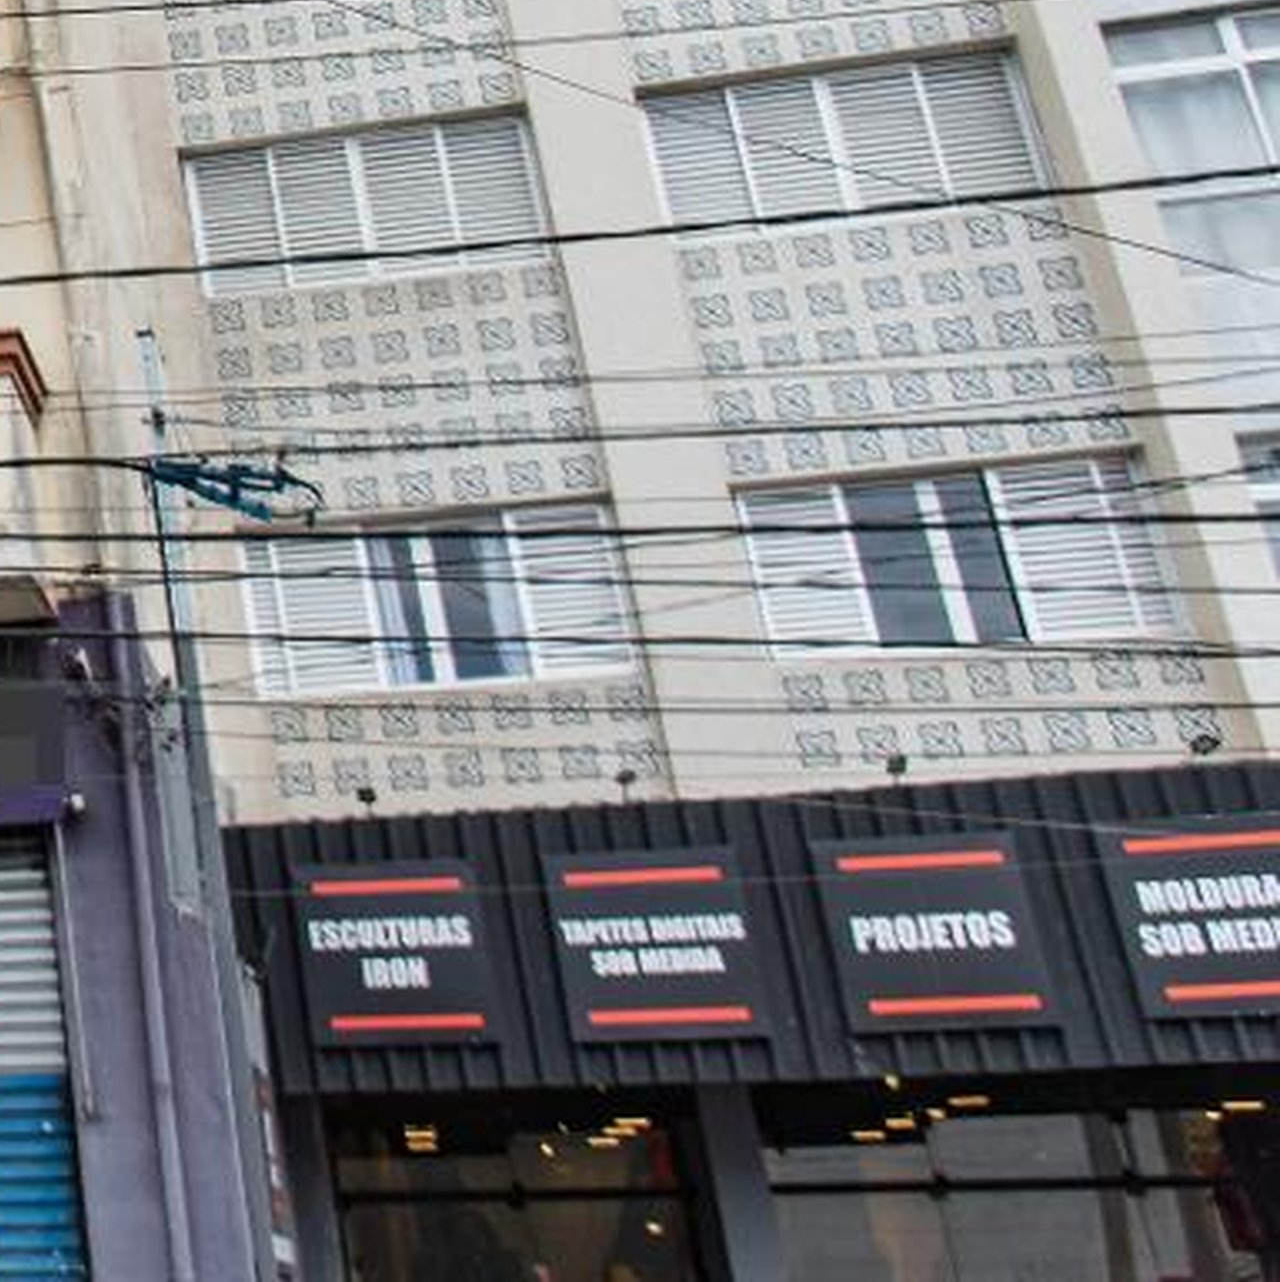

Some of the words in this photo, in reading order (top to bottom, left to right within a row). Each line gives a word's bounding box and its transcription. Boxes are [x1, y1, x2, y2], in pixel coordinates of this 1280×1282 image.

[308, 916, 472, 951] ESCULTURAS
[850, 910, 1016, 954] PROJETOS
[1139, 923, 1208, 958] SOB
[361, 956, 430, 989] IRON
